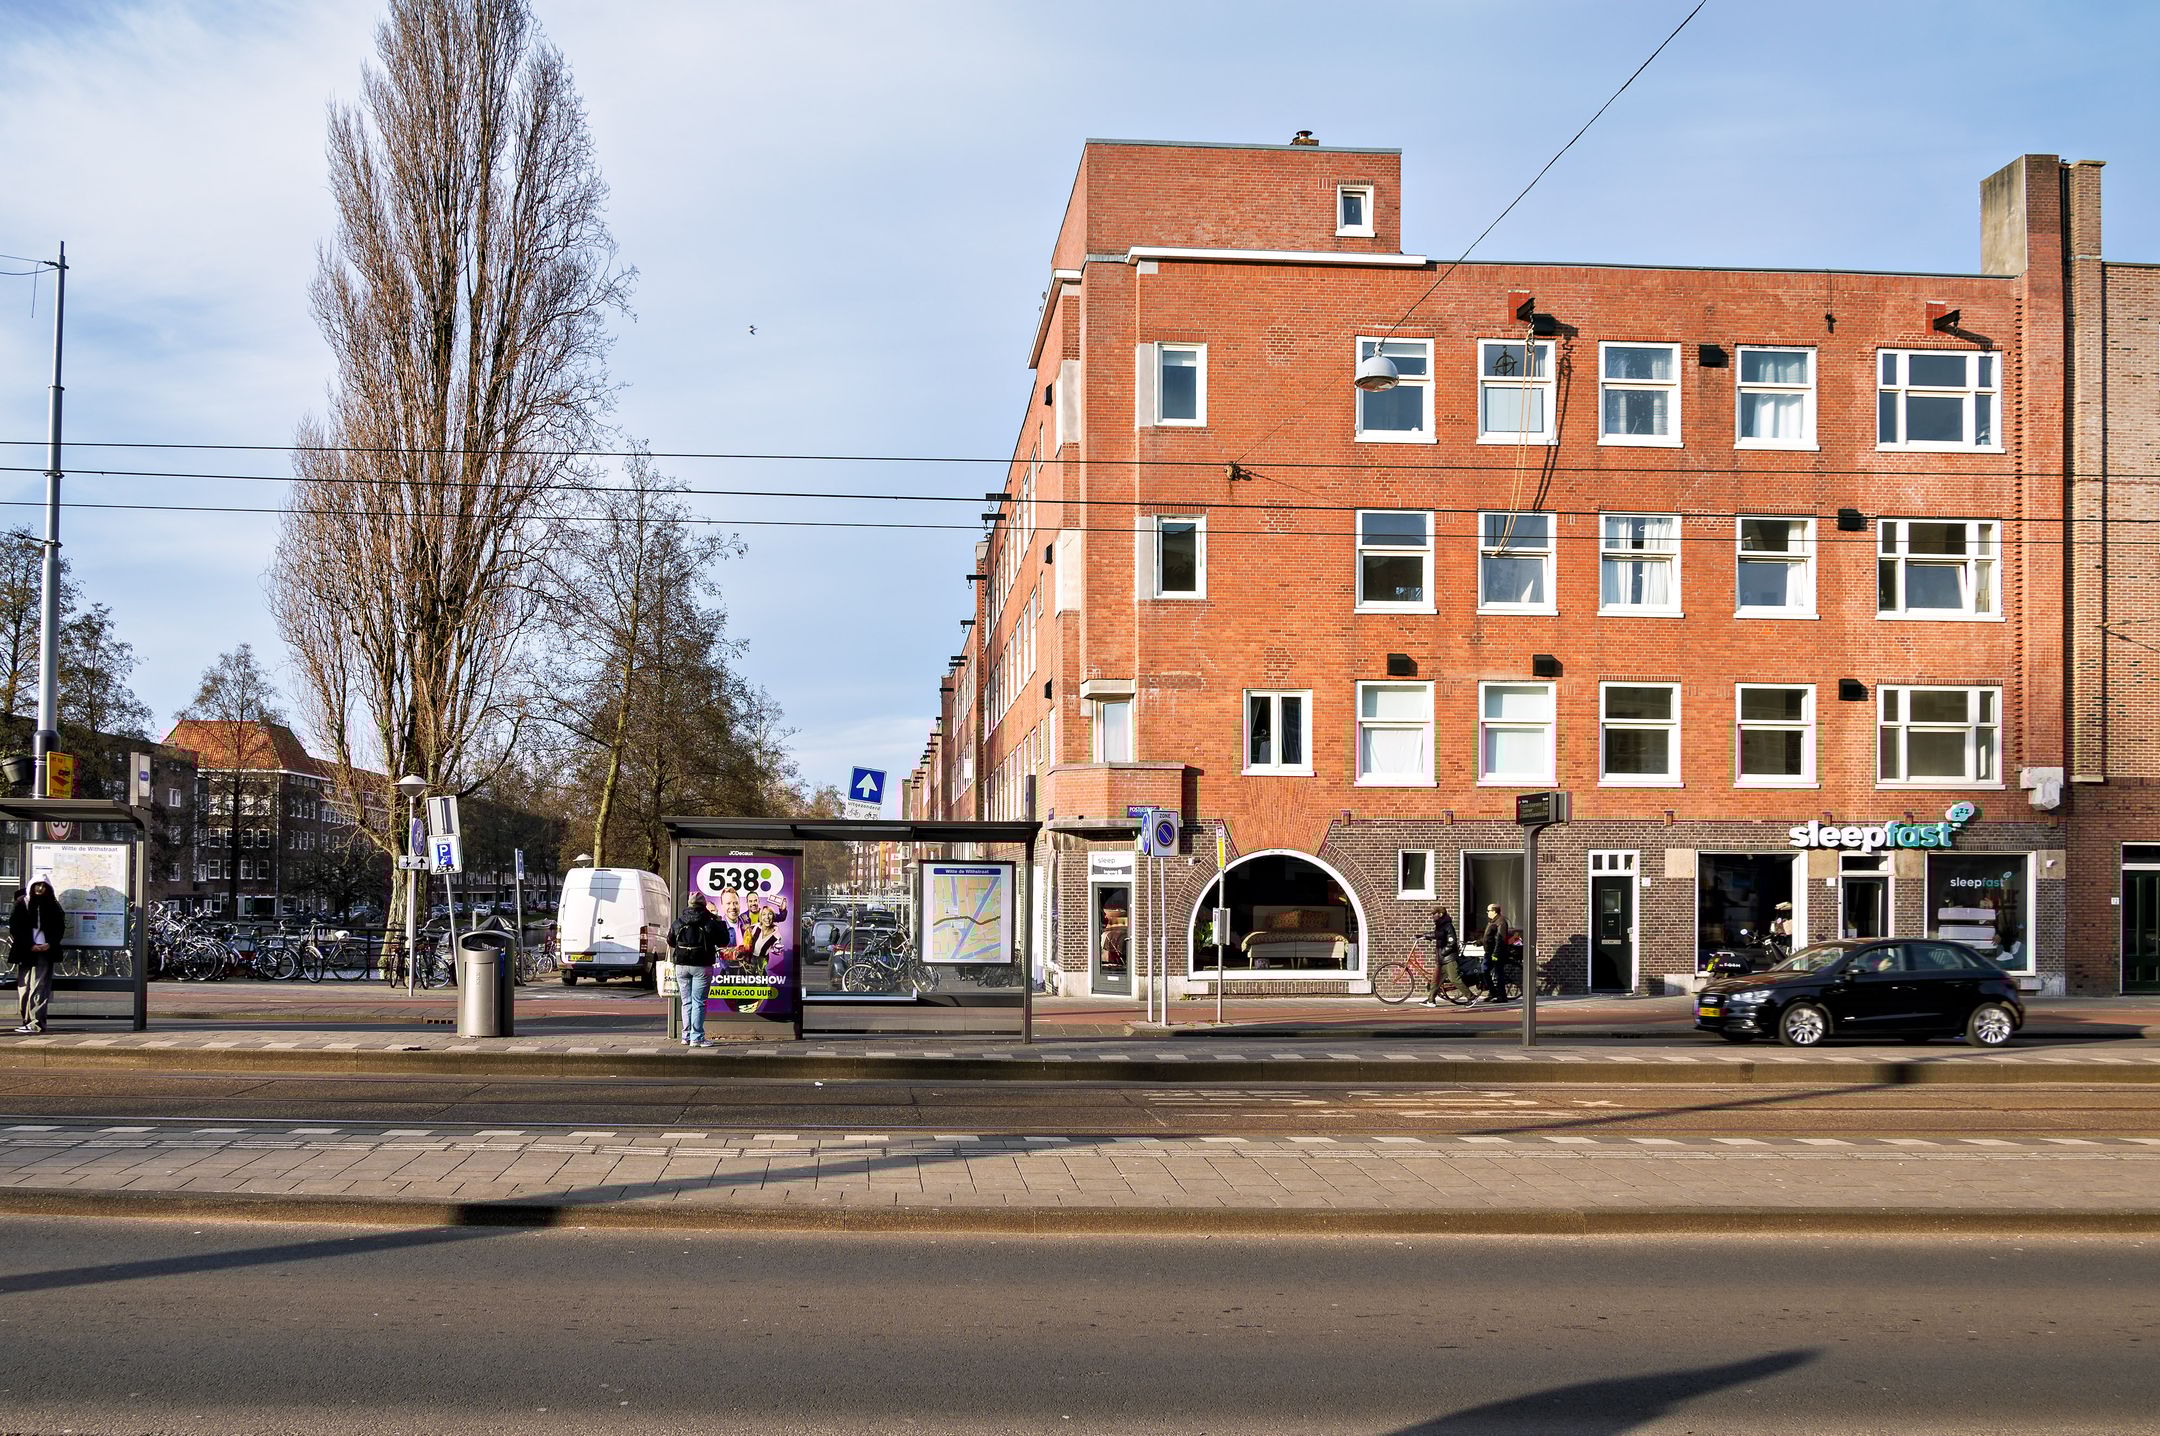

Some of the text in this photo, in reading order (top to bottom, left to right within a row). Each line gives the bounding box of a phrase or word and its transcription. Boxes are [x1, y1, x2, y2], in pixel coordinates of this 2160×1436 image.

[847, 801, 881, 811] uitgezonderd
[1788, 820, 1952, 852] sleepfast
[1950, 876, 2005, 889] sleepfast
[732, 989, 756, 997] 06:00
[757, 989, 773, 997] UUR
